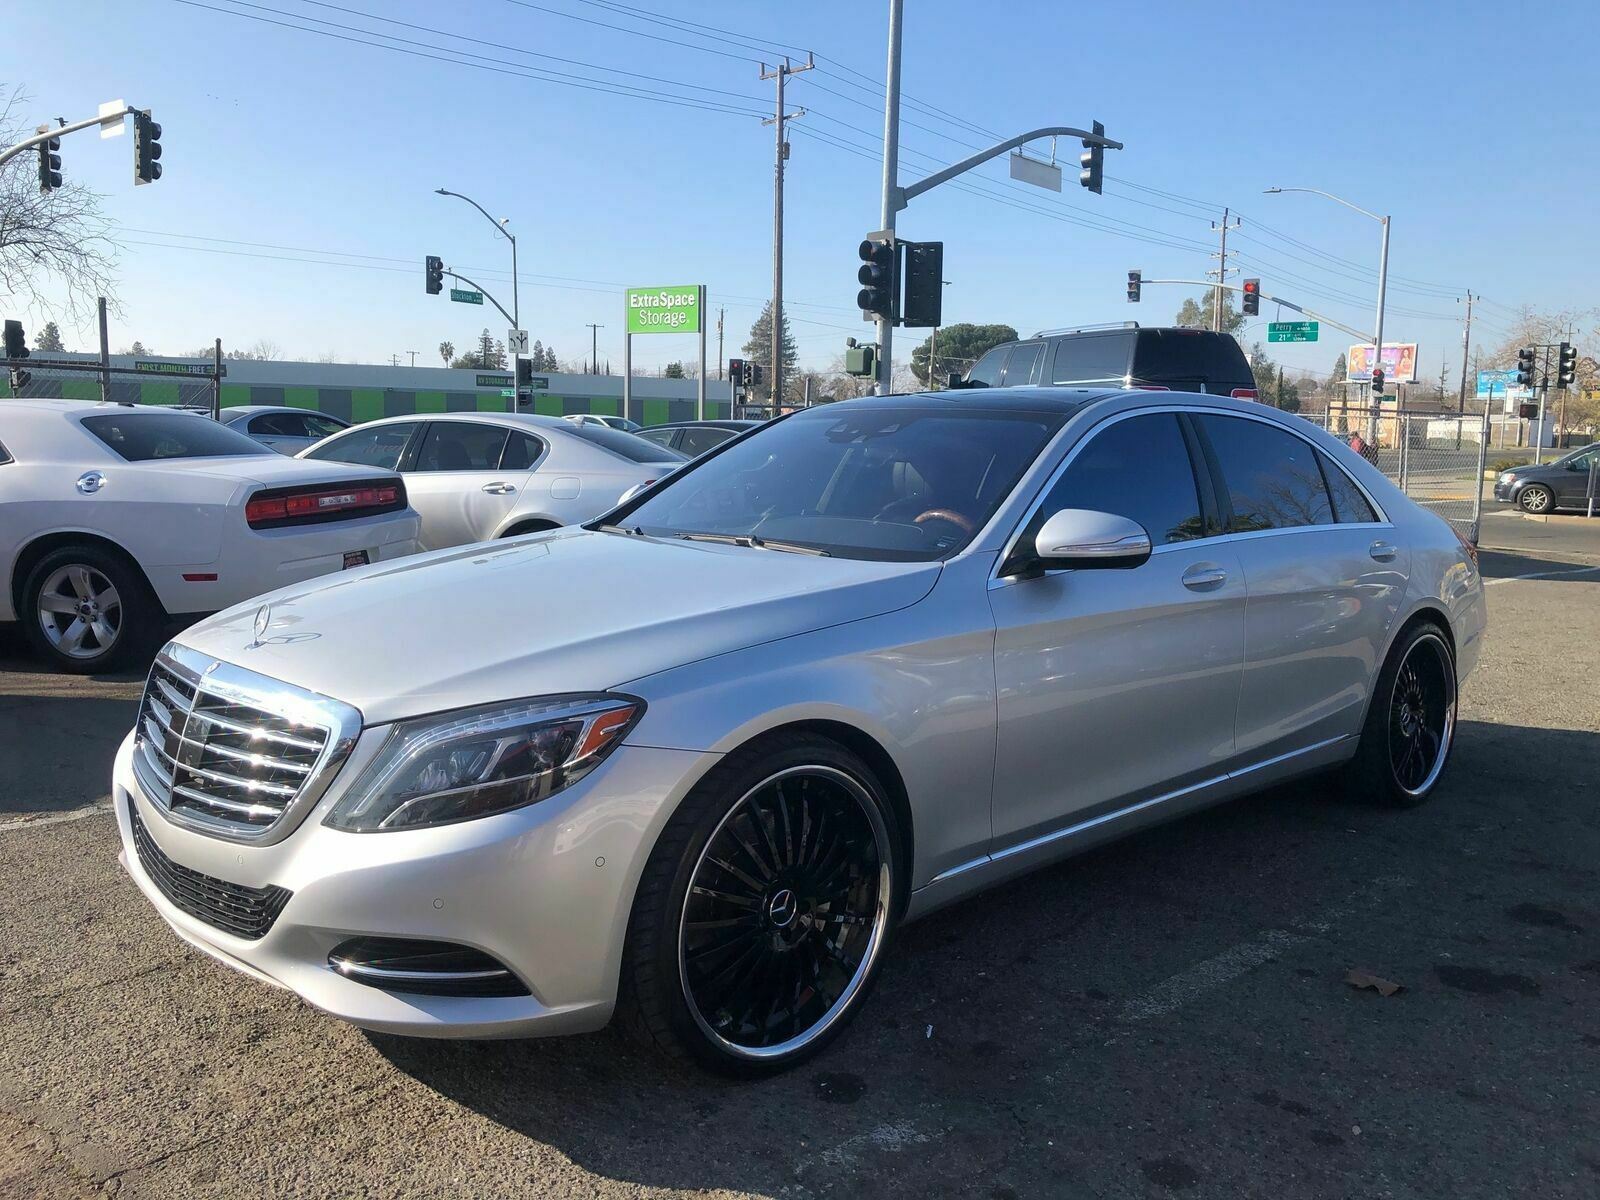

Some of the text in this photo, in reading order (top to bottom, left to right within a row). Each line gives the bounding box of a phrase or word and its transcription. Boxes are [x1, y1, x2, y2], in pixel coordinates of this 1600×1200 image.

[640, 310, 687, 327] Storage
[1275, 324, 1292, 332] Perry
[137, 363, 158, 371] FIRST
[160, 365, 187, 373] MONTH
[188, 365, 205, 373] FREE
